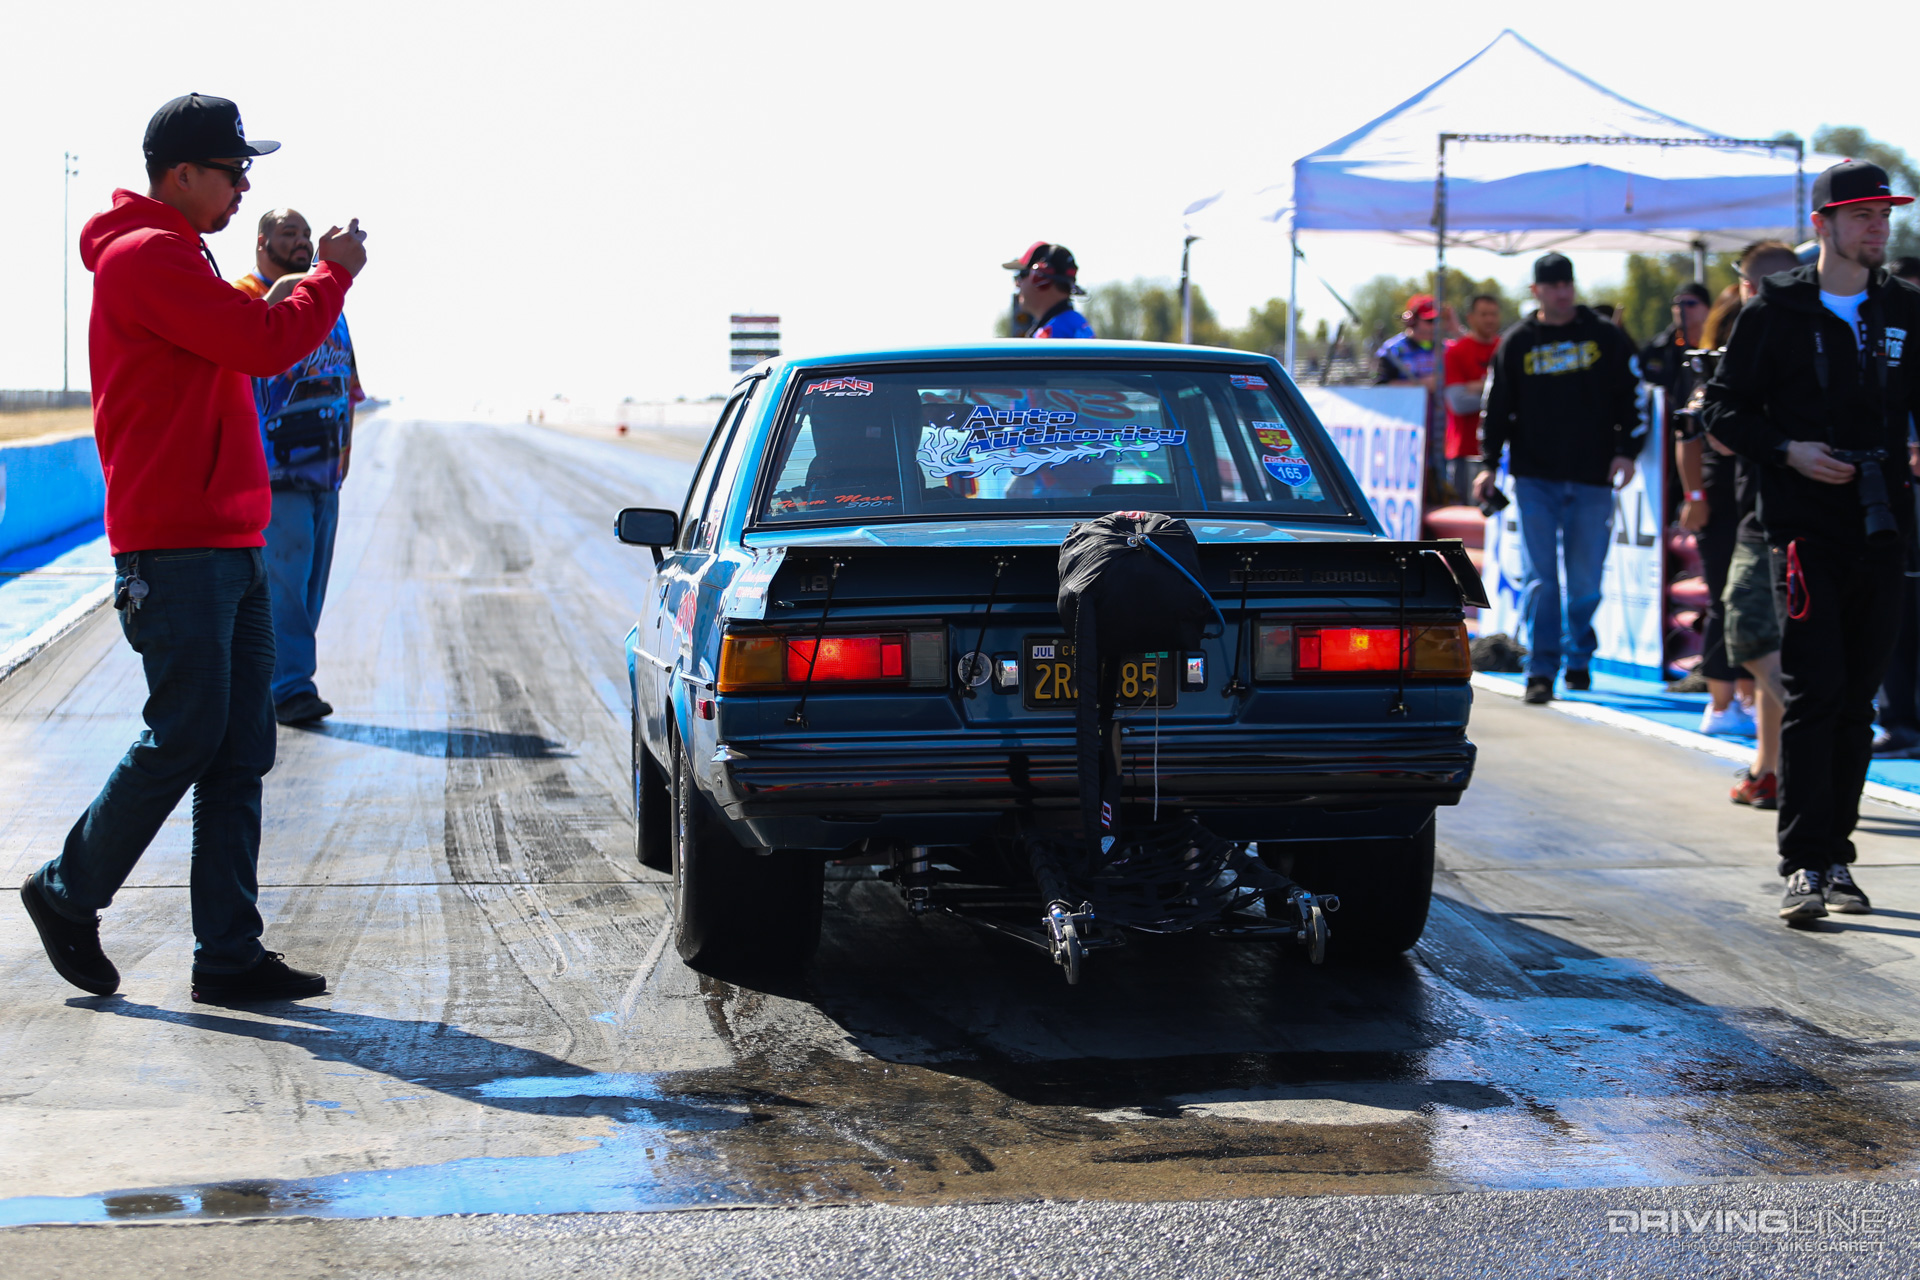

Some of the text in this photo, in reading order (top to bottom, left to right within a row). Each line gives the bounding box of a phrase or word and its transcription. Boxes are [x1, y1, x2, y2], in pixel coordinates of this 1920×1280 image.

[960, 405, 1077, 431] Auto
[957, 425, 1188, 458] Authority
[1277, 466, 1303, 480] 165
[1233, 569, 1399, 583] TOYOTA COROLLA
[1033, 647, 1054, 658] JUL
